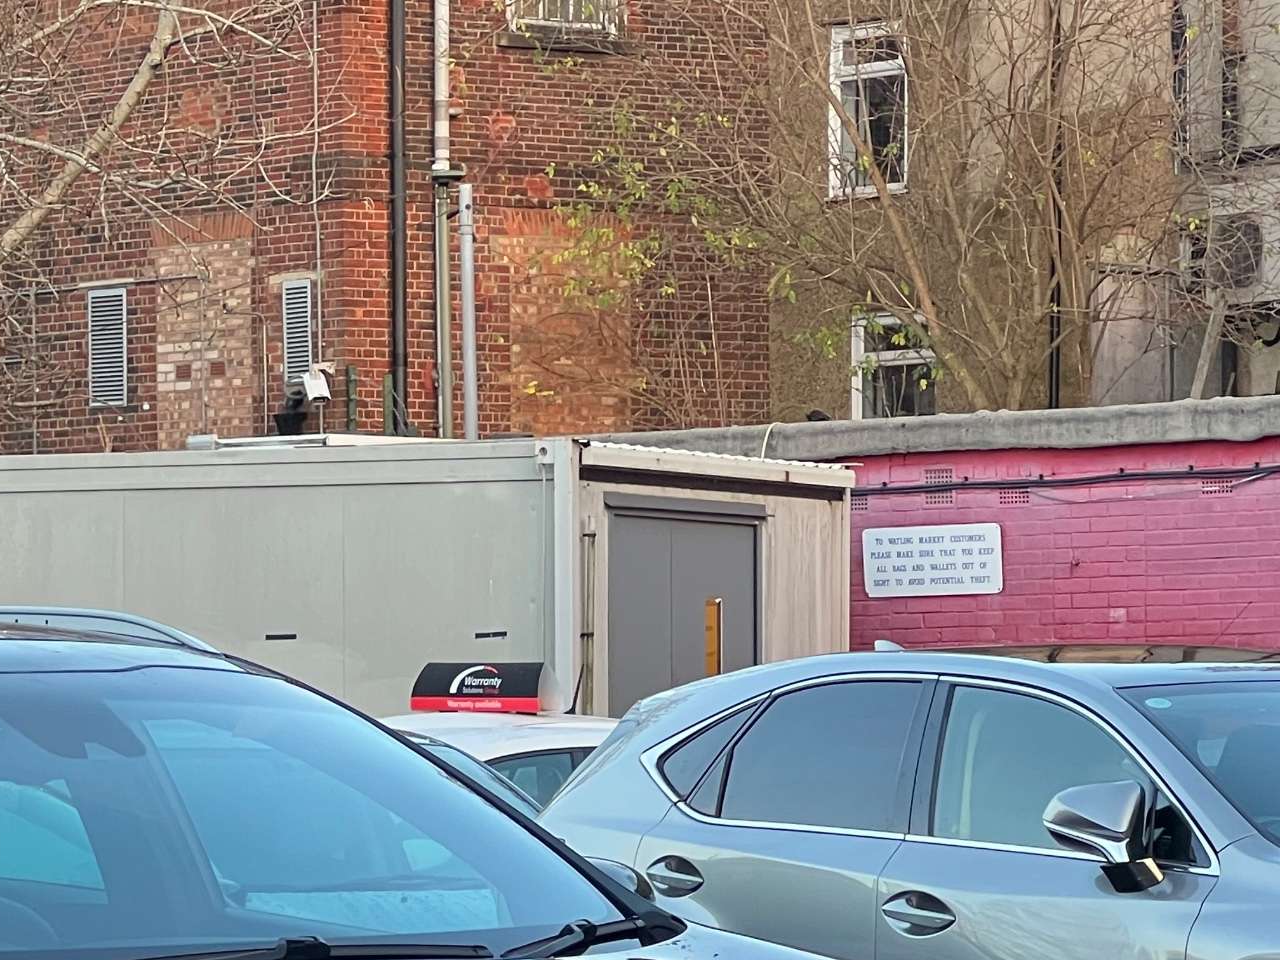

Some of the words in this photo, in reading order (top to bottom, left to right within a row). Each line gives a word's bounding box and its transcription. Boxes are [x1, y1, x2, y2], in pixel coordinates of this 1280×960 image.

[919, 536, 944, 544] MARKET
[870, 551, 891, 559] PLEASE
[961, 548, 973, 556] YOU
[979, 547, 994, 555] KEEP
[876, 565, 888, 573] ALL
[895, 578, 903, 586] TO
[970, 575, 991, 583] THEFT
[464, 676, 502, 688] Warranty
